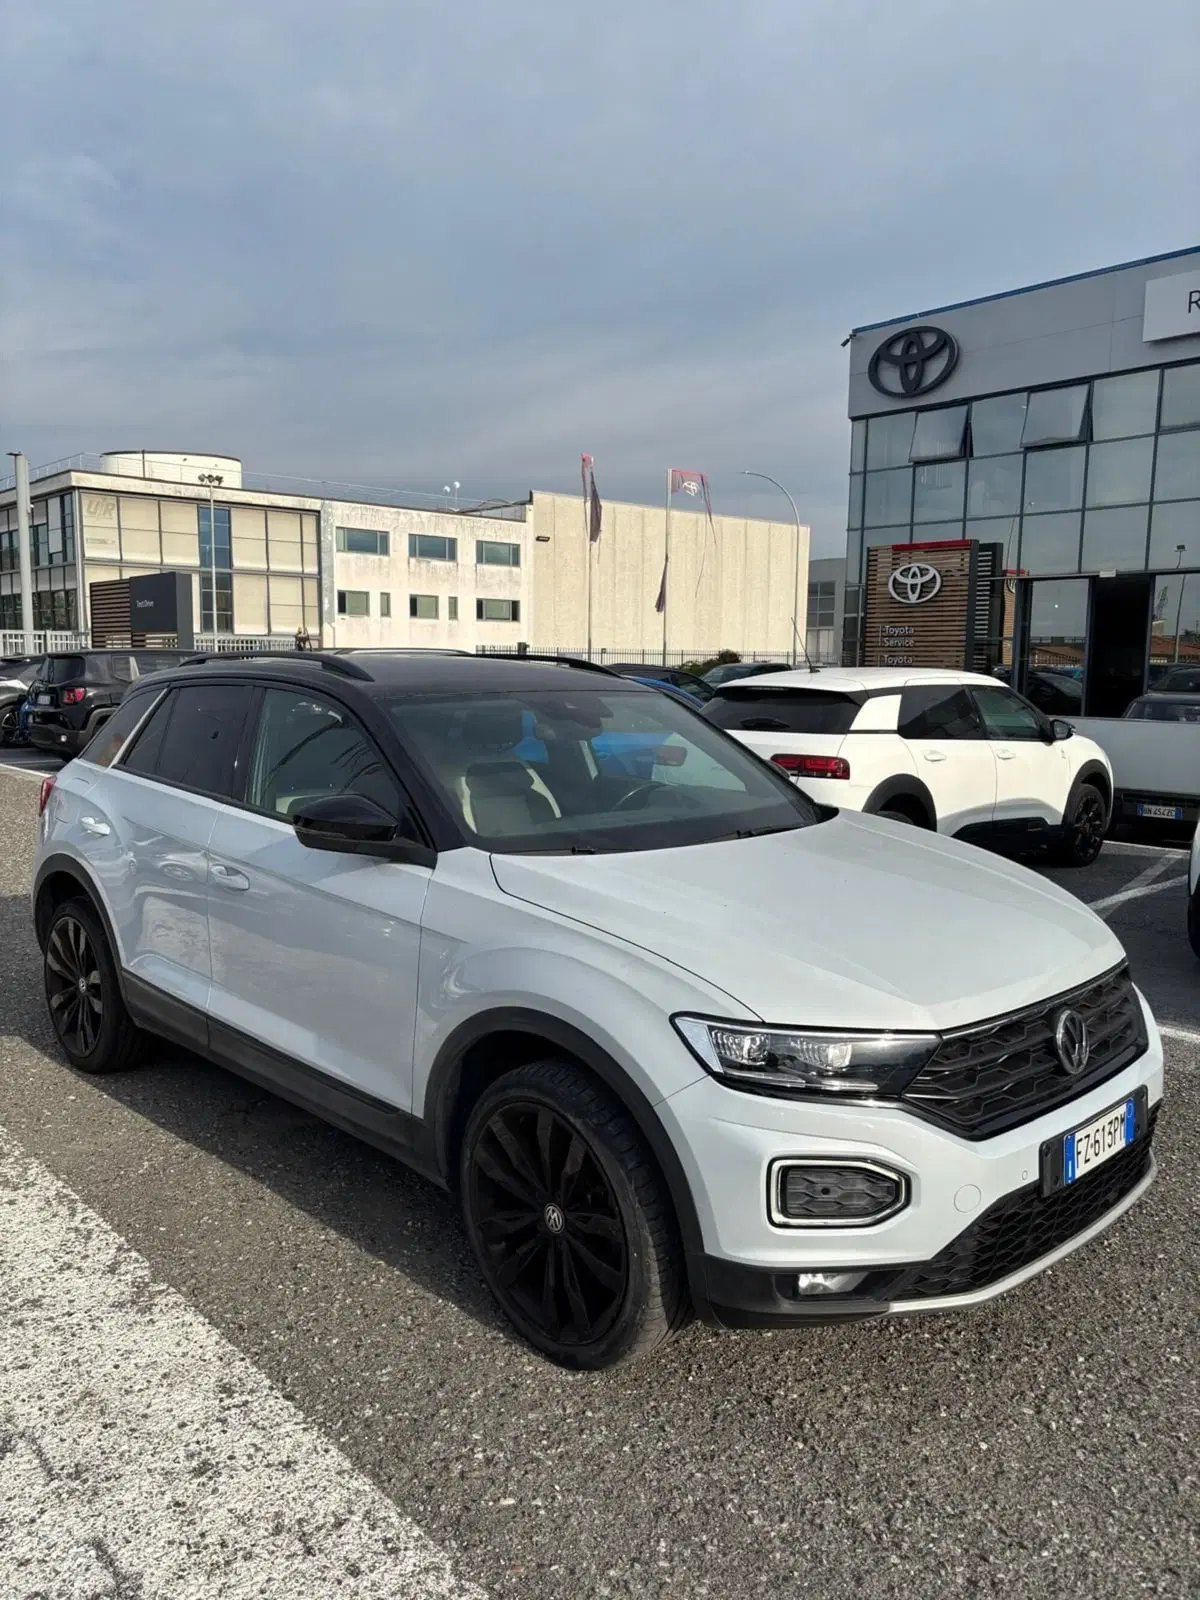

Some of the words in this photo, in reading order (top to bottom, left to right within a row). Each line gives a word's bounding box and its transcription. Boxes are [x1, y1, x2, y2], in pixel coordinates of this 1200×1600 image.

[884, 624, 914, 636] Toyota
[883, 637, 914, 647] Service
[883, 654, 913, 666] Toyota
